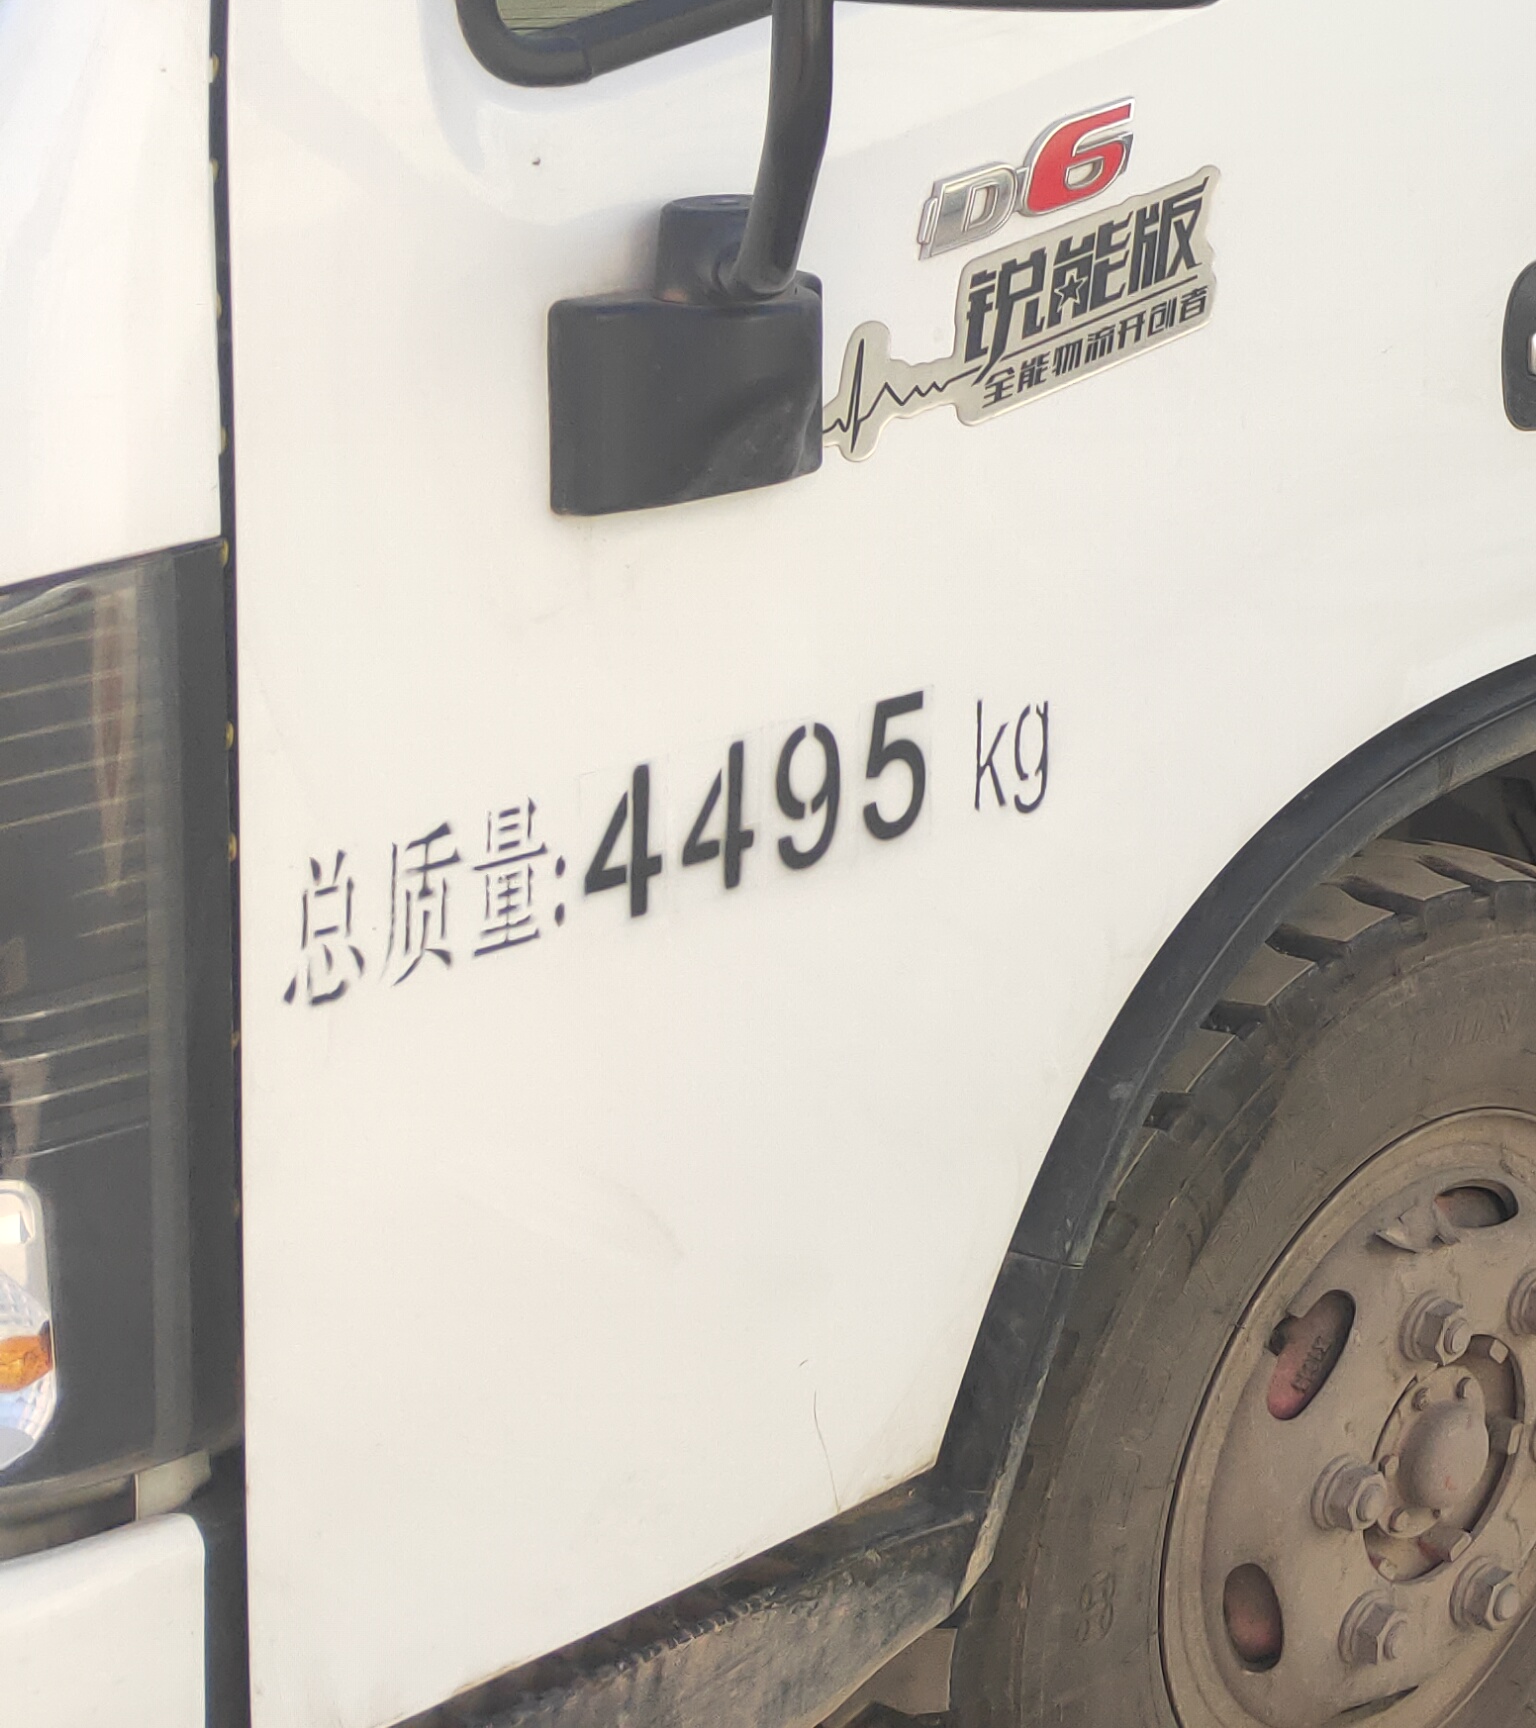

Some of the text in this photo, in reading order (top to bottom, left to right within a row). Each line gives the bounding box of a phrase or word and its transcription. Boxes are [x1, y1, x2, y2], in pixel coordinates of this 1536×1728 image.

[964, 176, 1209, 387] 锐能版
[982, 285, 1208, 409] 全能物流开创者
[973, 697, 1050, 815] kg
